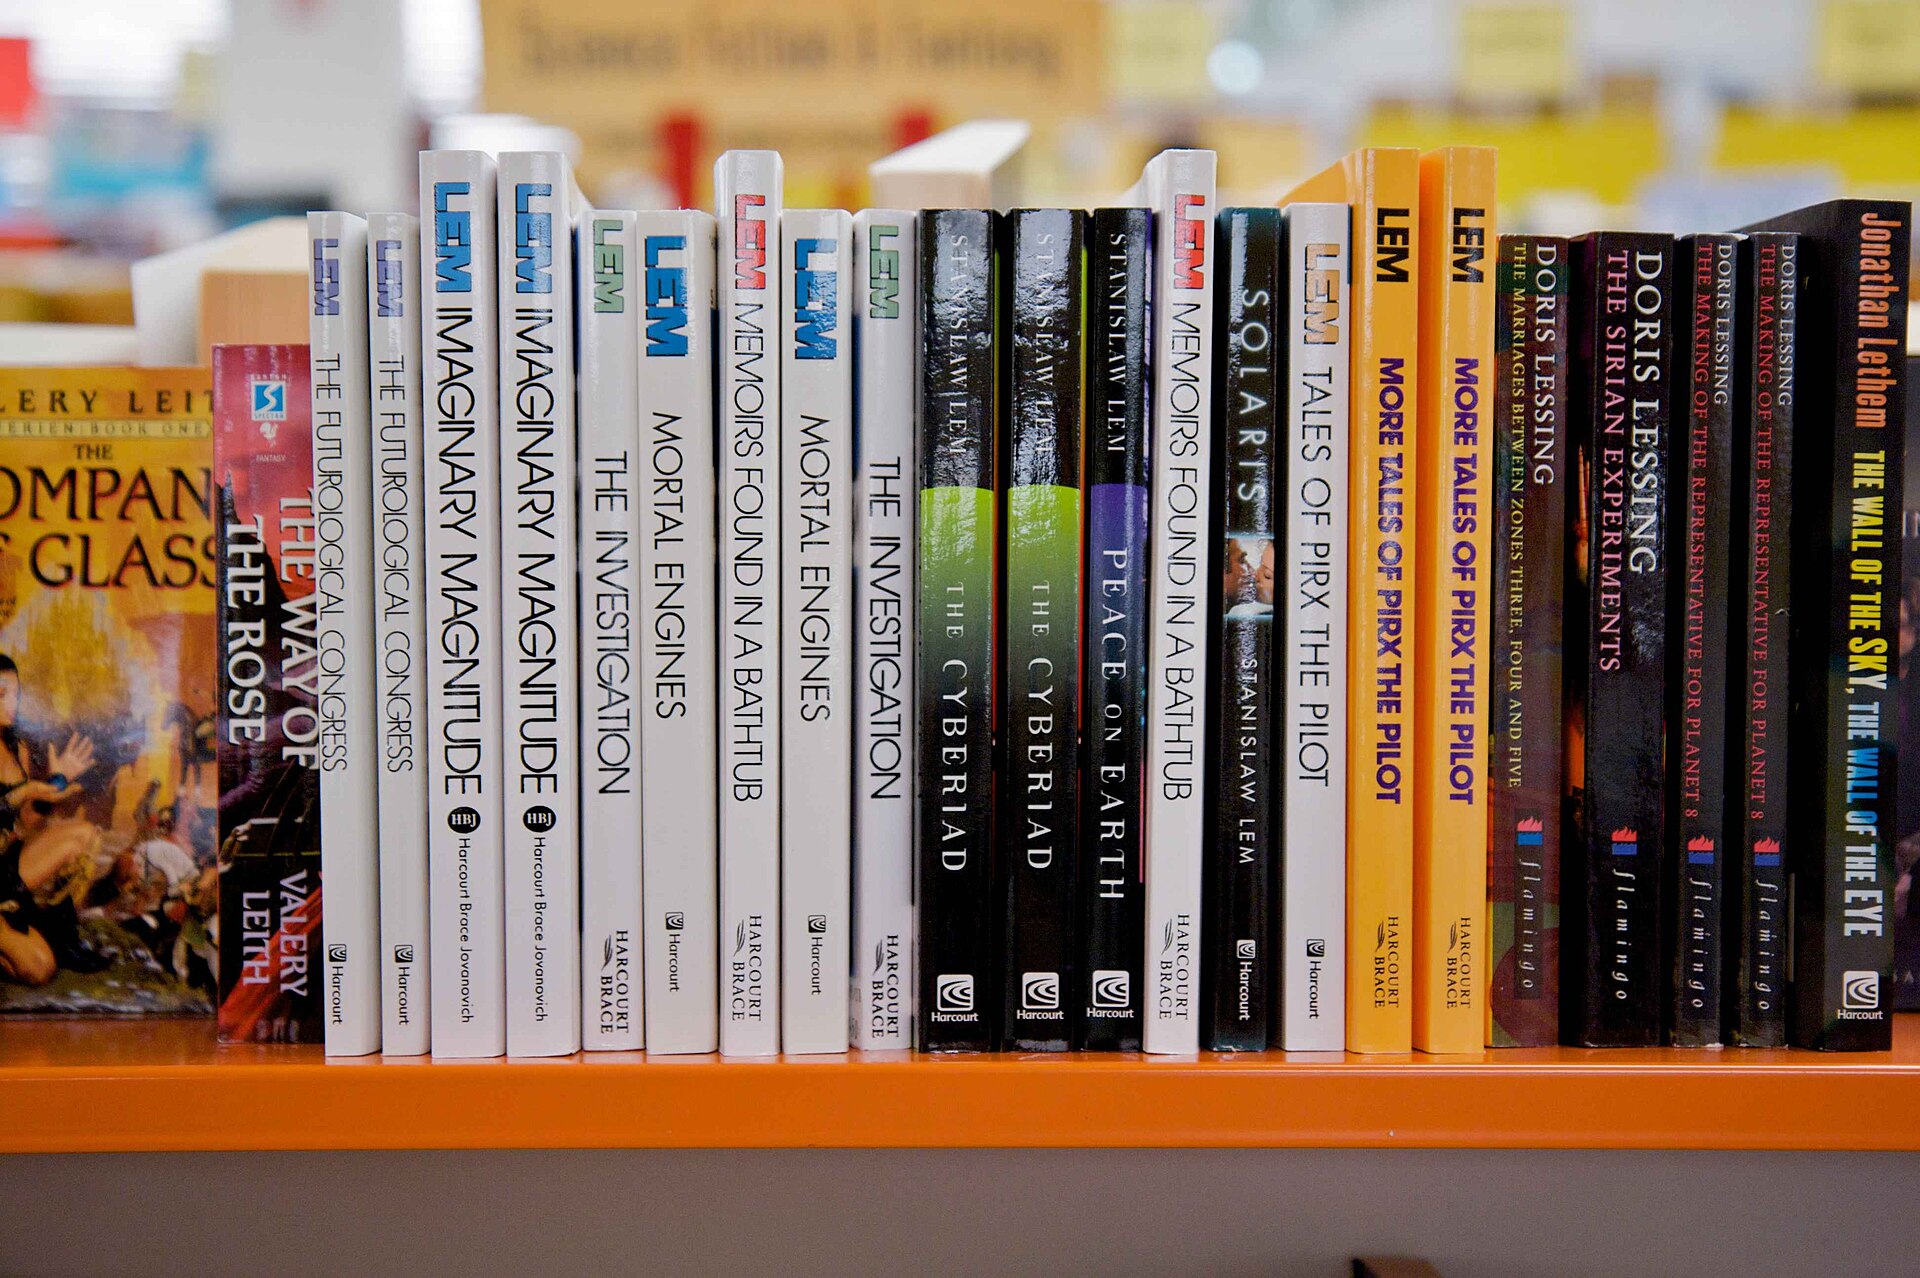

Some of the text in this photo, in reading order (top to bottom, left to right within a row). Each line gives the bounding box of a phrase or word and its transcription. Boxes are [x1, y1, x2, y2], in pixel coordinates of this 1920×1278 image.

[1107, 233, 1127, 451] STANISLAW LEM
[1238, 289, 1270, 500] SOLARIS
[1533, 244, 1557, 485] DORIS LESSING
[1714, 244, 1732, 405] DORIS LESSING
[1778, 244, 1795, 406] DORIS LESSING
[1855, 212, 1901, 428] Jonathan Lethem
[74, 443, 113, 460] THE
[434, 181, 482, 795] LEM IMAGINARY MAGNITUDE
[515, 183, 558, 794] LEM IMAGINARY MAGNITUDE
[645, 235, 688, 719] LEM MORTAL ENGINES
[794, 238, 837, 721] LEM MORTAL ENGINES
[1600, 250, 1629, 672] THE SIRIAN EXPERIMENTS
[1630, 251, 1662, 574] DORIS LESSING
[313, 239, 347, 772] LEM THE FUTUROLOGICAL CONGRESS
[376, 239, 413, 773] LEM THE FUTUROLOGICAL CONGRESS
[593, 219, 631, 794] LEM THE INVESTIGATION
[733, 194, 766, 802] LEM MEMOIRS FOUND IN A BATHTUB
[869, 225, 902, 799] LEM THE INVESTIGATION
[1163, 194, 1205, 800] LEM MEMOIRS FOUND IN A BATHTUB
[1299, 243, 1340, 787] LEM TALES OF PIRX THE PILOT
[1376, 207, 1410, 805] LEM MORE TALES OF PIRX THE PILOT
[1450, 207, 1485, 805] LEM MORE TALES OF PIRX THE PILOT
[1509, 243, 1526, 788] THE MARRIAGES BETWEEN ZONES FOUR AND FIVE
[1685, 243, 1713, 802] THE MAKING THE REPRESENTATIVE FOR PLANET
[1751, 295, 1774, 803] MAKING REPRESENTATIVE PLANET
[227, 514, 267, 745] THE ROSE
[280, 487, 318, 696] THE WAY
[942, 581, 968, 870] THE CYBERIAD
[1027, 580, 1053, 869] THE CYBERIAD
[1100, 547, 1129, 898] PEACE ON EARTH
[1239, 658, 1258, 863] STANISLAW LEM
[1844, 450, 1888, 936] THE WALL OF THE SKY, THE WALL OF THE EYE
[451, 813, 477, 828] HBJ
[526, 812, 553, 827] HBJ
[242, 890, 271, 986] LEITH
[279, 869, 308, 997] VALERY
[332, 965, 342, 1025] Harcourt
[398, 966, 409, 1025] Harcourt
[458, 837, 474, 1023] Harcourt Brace Jovanovich
[533, 837, 548, 1022] Harcourt Brace Jovanovich
[616, 930, 629, 1034] HARCOURT
[669, 933, 679, 992] Harcourt
[732, 961, 745, 1021] BRACE
[749, 914, 762, 1021] HARCOURT
[811, 936, 822, 995] Harcourt
[886, 934, 899, 1038] HARCOURT
[1159, 960, 1173, 1019] BRACE
[1176, 914, 1190, 1021] HARCOURT
[1239, 962, 1252, 1021] Harcourt
[1309, 961, 1321, 1019] Harcourt
[1374, 957, 1385, 1009] BRACE
[1387, 916, 1399, 1008] HARCOURT
[1447, 957, 1458, 1009] BRACE
[1460, 917, 1471, 1009] HARCOURT
[1519, 859, 1541, 988] flamingo
[1612, 868, 1635, 999] flamingo
[1689, 877, 1713, 1008] flamingo
[1755, 879, 1778, 1010] flamingo
[600, 975, 613, 1034] BRACE
[871, 980, 884, 1038] BRACE
[931, 1012, 979, 1022] Harcourt
[1016, 1010, 1064, 1020] Harcourt
[1087, 1008, 1134, 1018] Harcourt
[1837, 1010, 1883, 1021] Harcourt
